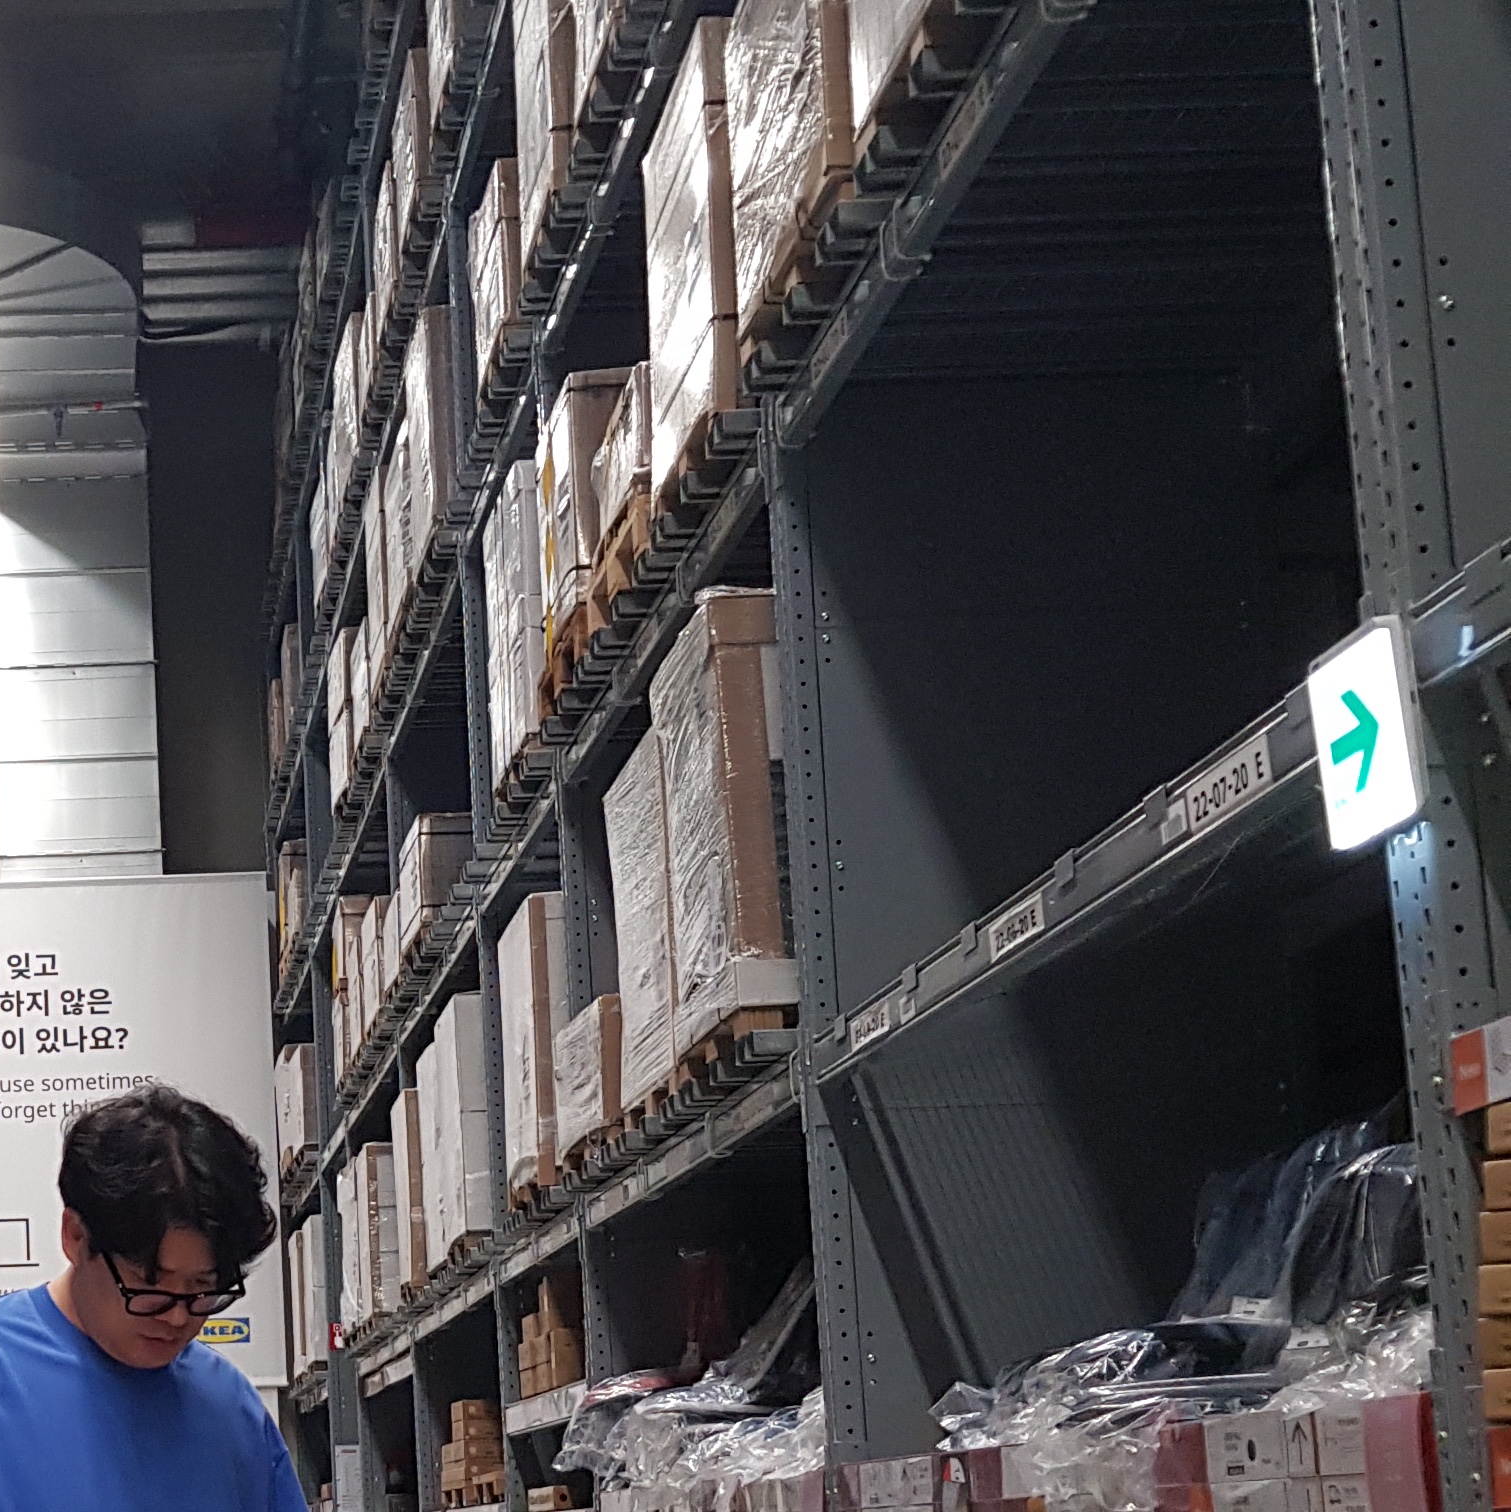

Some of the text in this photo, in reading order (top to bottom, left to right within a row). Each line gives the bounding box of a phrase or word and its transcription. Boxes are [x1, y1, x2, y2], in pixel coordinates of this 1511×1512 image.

[1193, 751, 1264, 822] 22-07-20 E
[1030, 909, 1037, 927] E
[6, 952, 59, 980] 잊고
[60, 988, 113, 1016] 않은
[35, 1025, 129, 1054] 있나요?
[41, 1073, 154, 1092] sometimes
[202, 1325, 245, 1336] KEA
